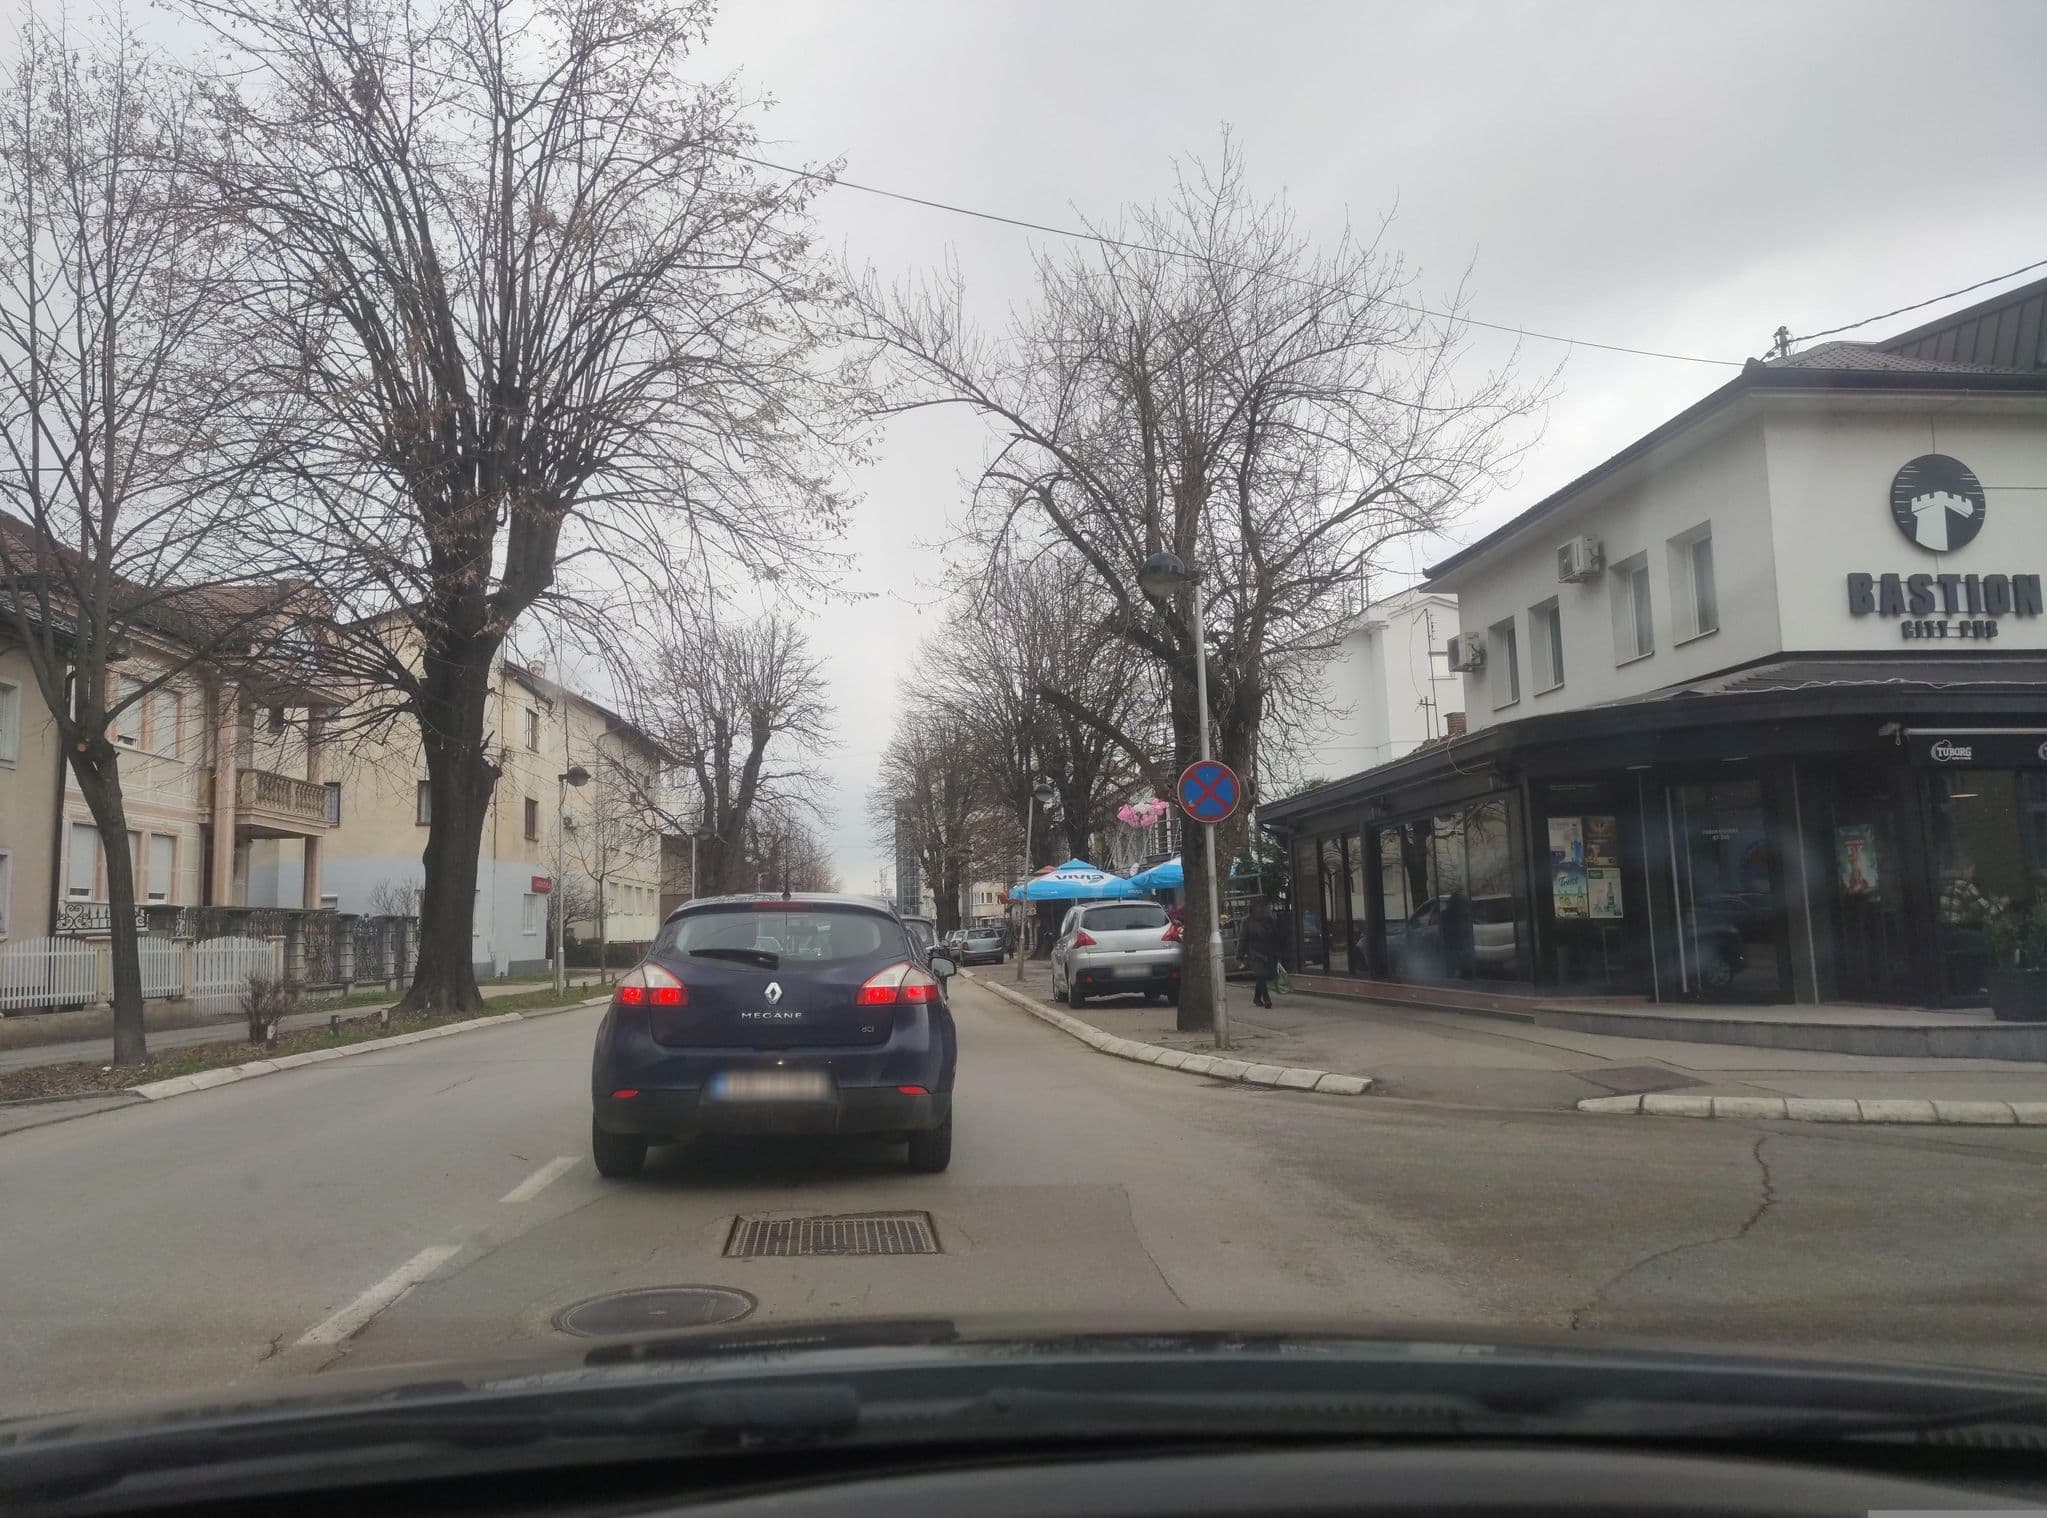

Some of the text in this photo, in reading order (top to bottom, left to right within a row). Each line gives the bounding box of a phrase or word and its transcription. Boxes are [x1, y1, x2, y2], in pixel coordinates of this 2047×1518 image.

[1847, 572, 2044, 616] BASTION
[1901, 620, 1999, 639] CITY PUB
[1936, 746, 1972, 757] TUBORG
[1055, 873, 1105, 882] VIVIA
